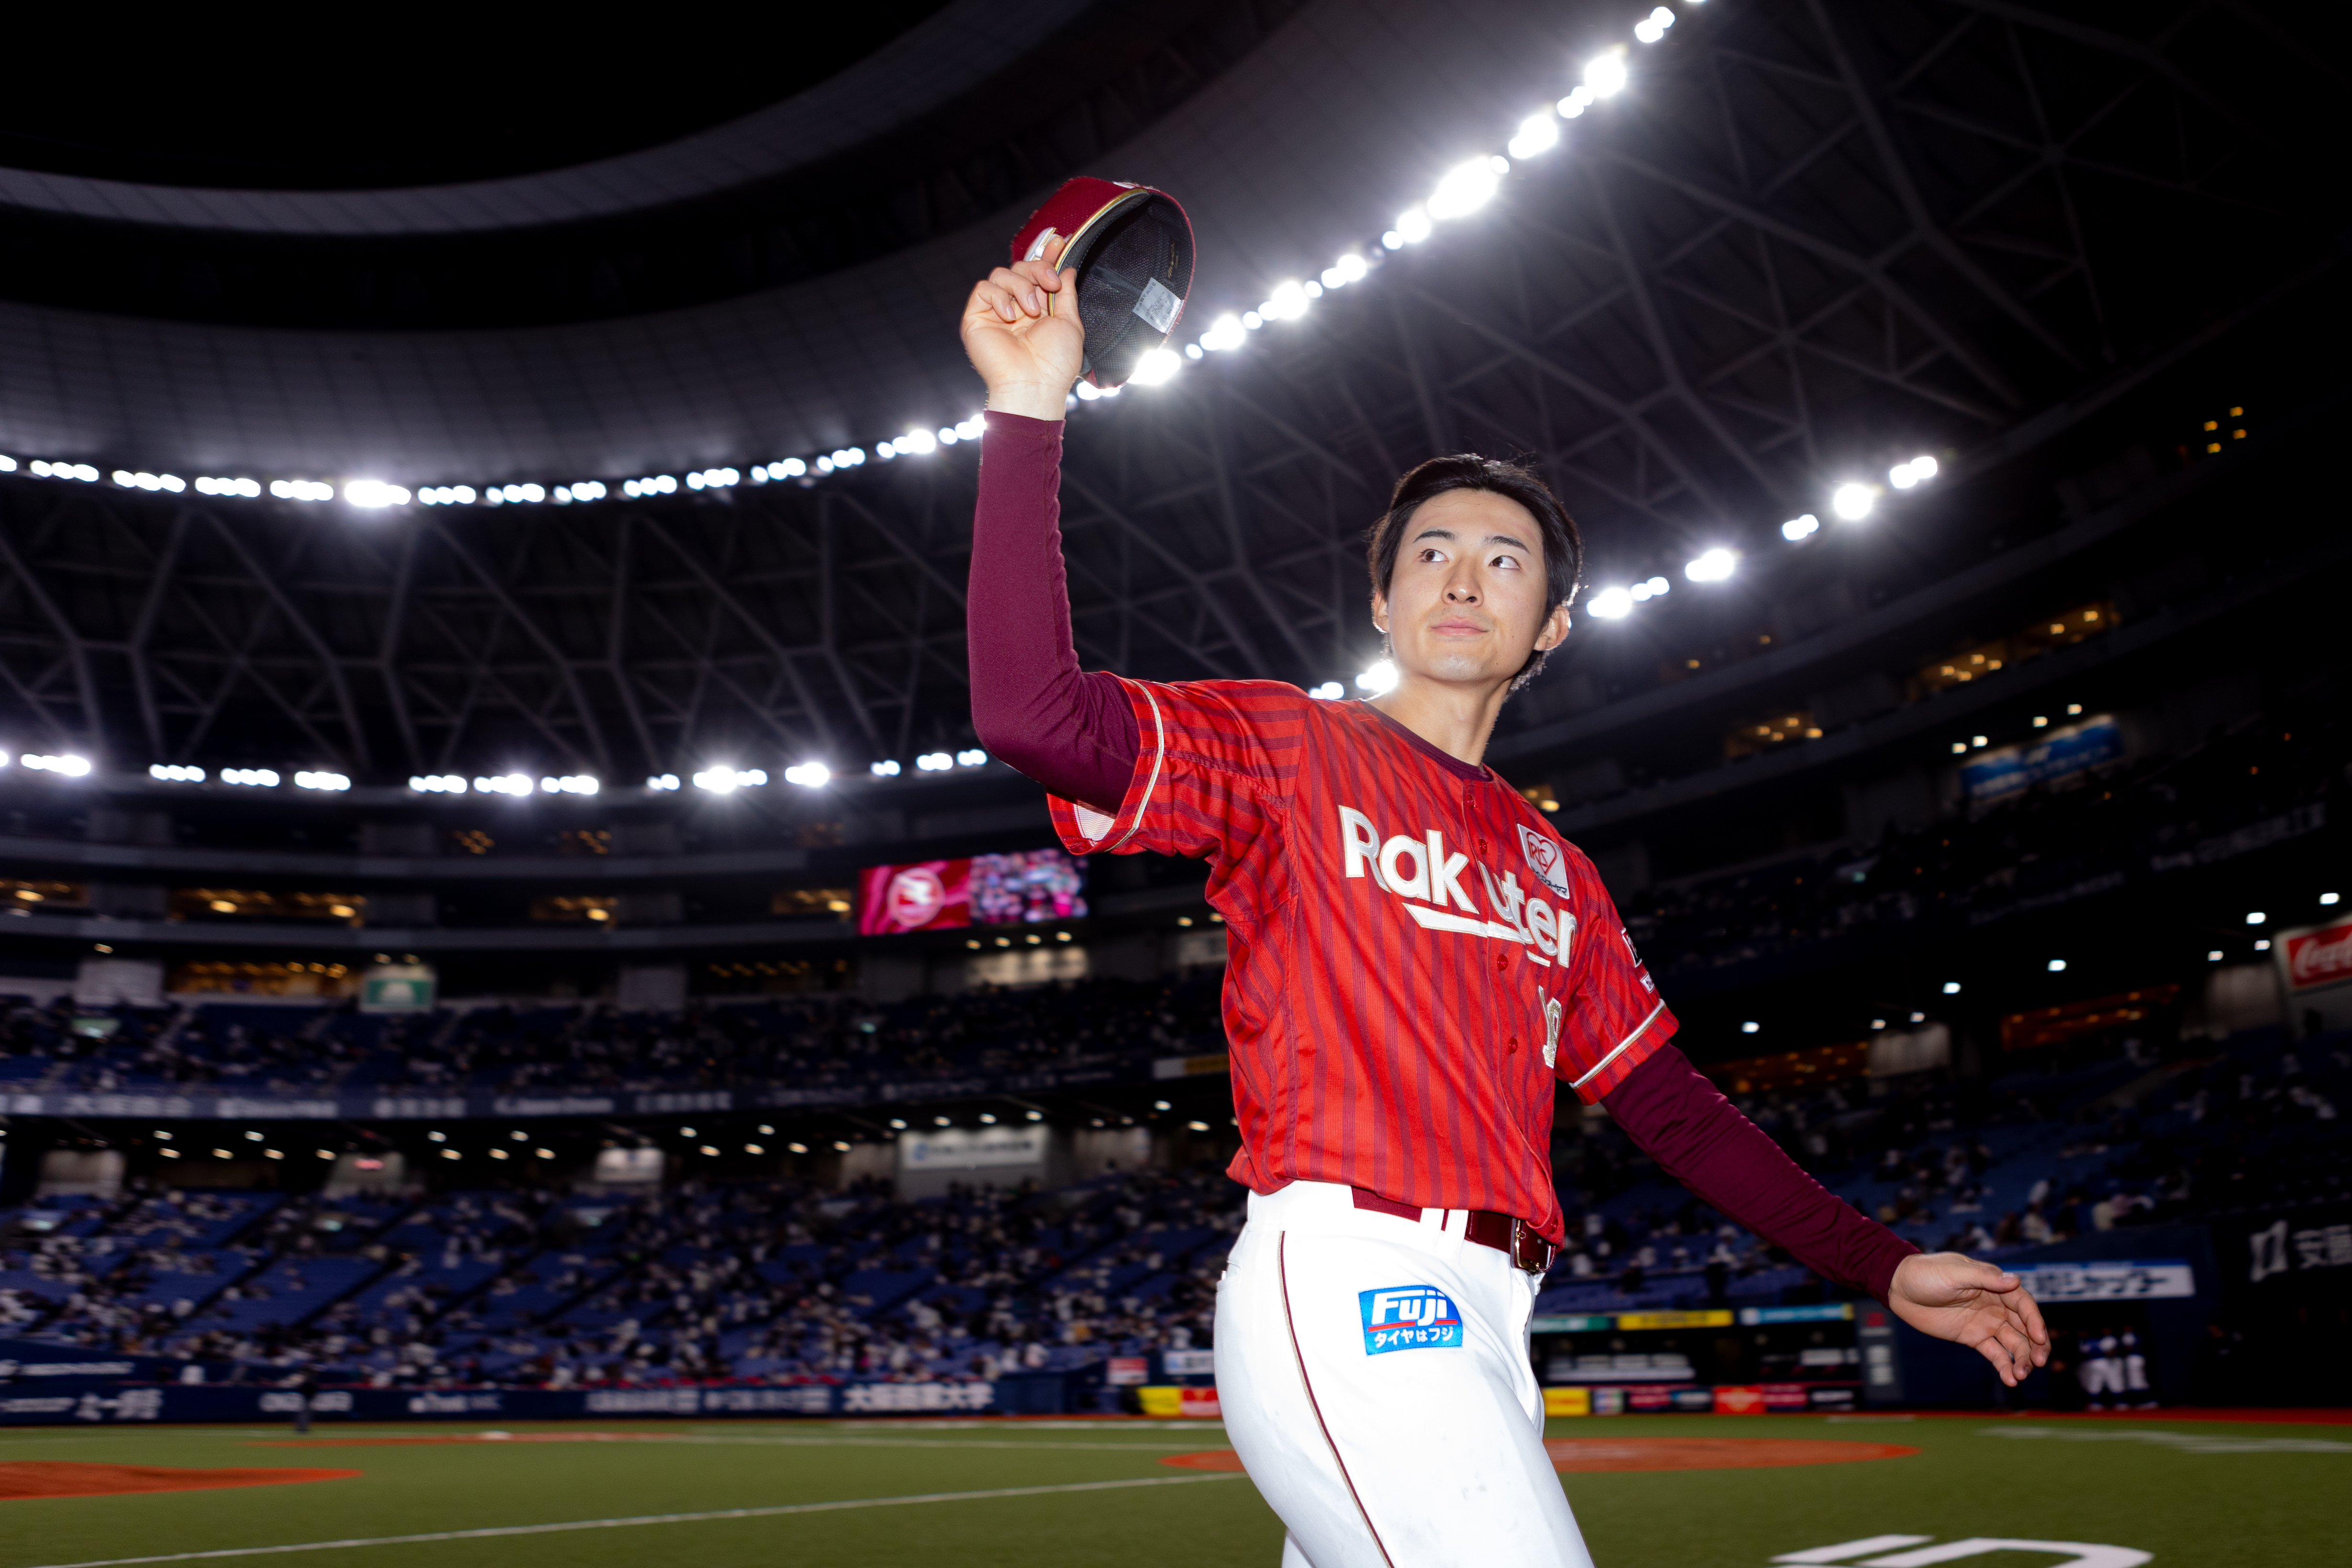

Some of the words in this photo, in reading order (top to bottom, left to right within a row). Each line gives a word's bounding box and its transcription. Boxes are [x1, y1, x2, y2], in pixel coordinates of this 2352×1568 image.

[1338, 805, 1577, 969] Rakuten
[1371, 1289, 1447, 1327] Fuji
[1374, 1326, 1454, 1348] タイヤはフジ
